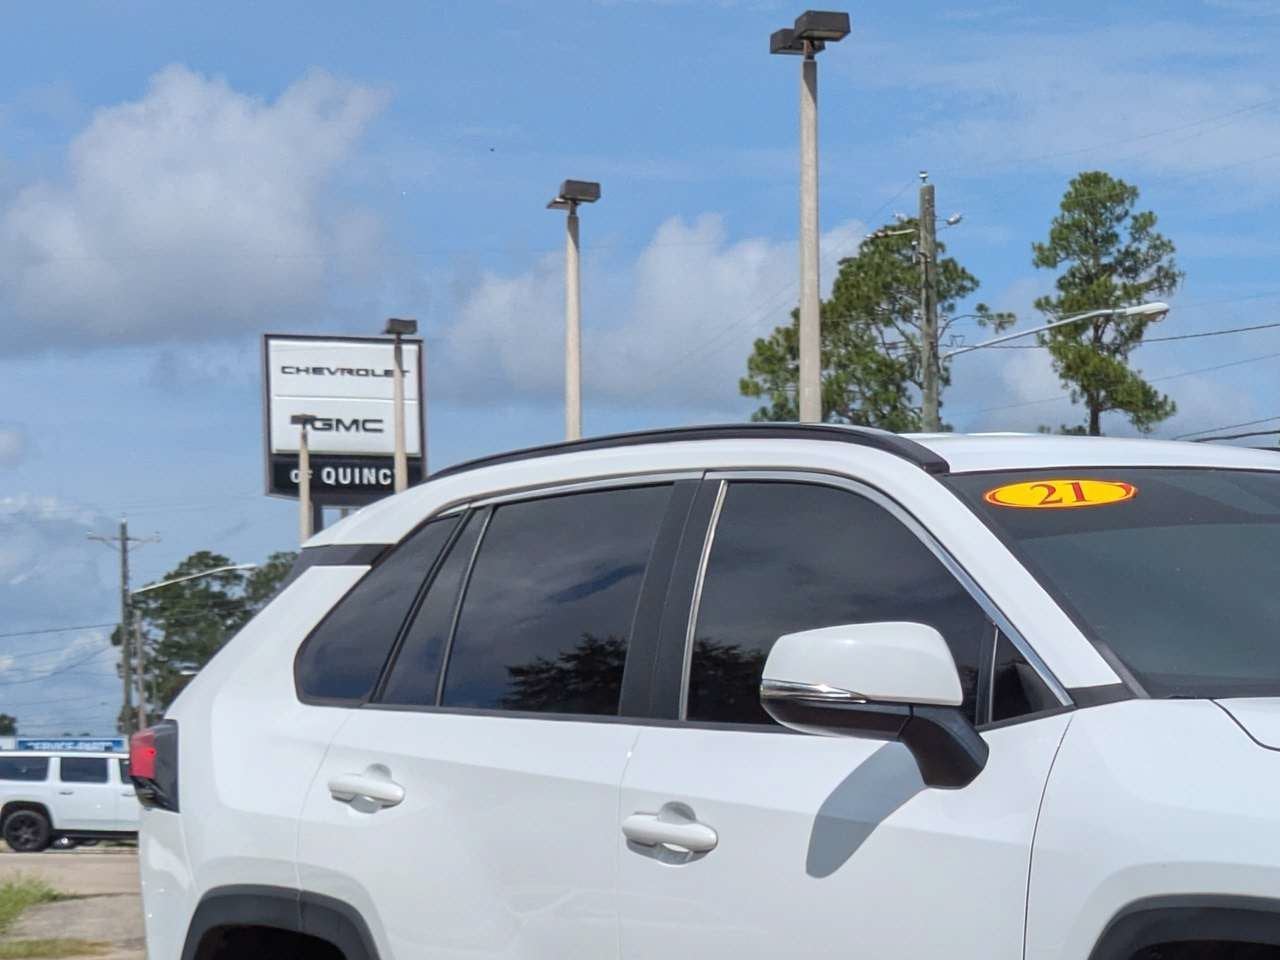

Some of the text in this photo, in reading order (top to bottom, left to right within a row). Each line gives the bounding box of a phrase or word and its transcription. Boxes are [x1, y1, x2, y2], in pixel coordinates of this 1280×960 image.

[311, 417, 385, 434] GMC
[289, 466, 396, 486] O QUINC
[1029, 480, 1087, 506] 21
